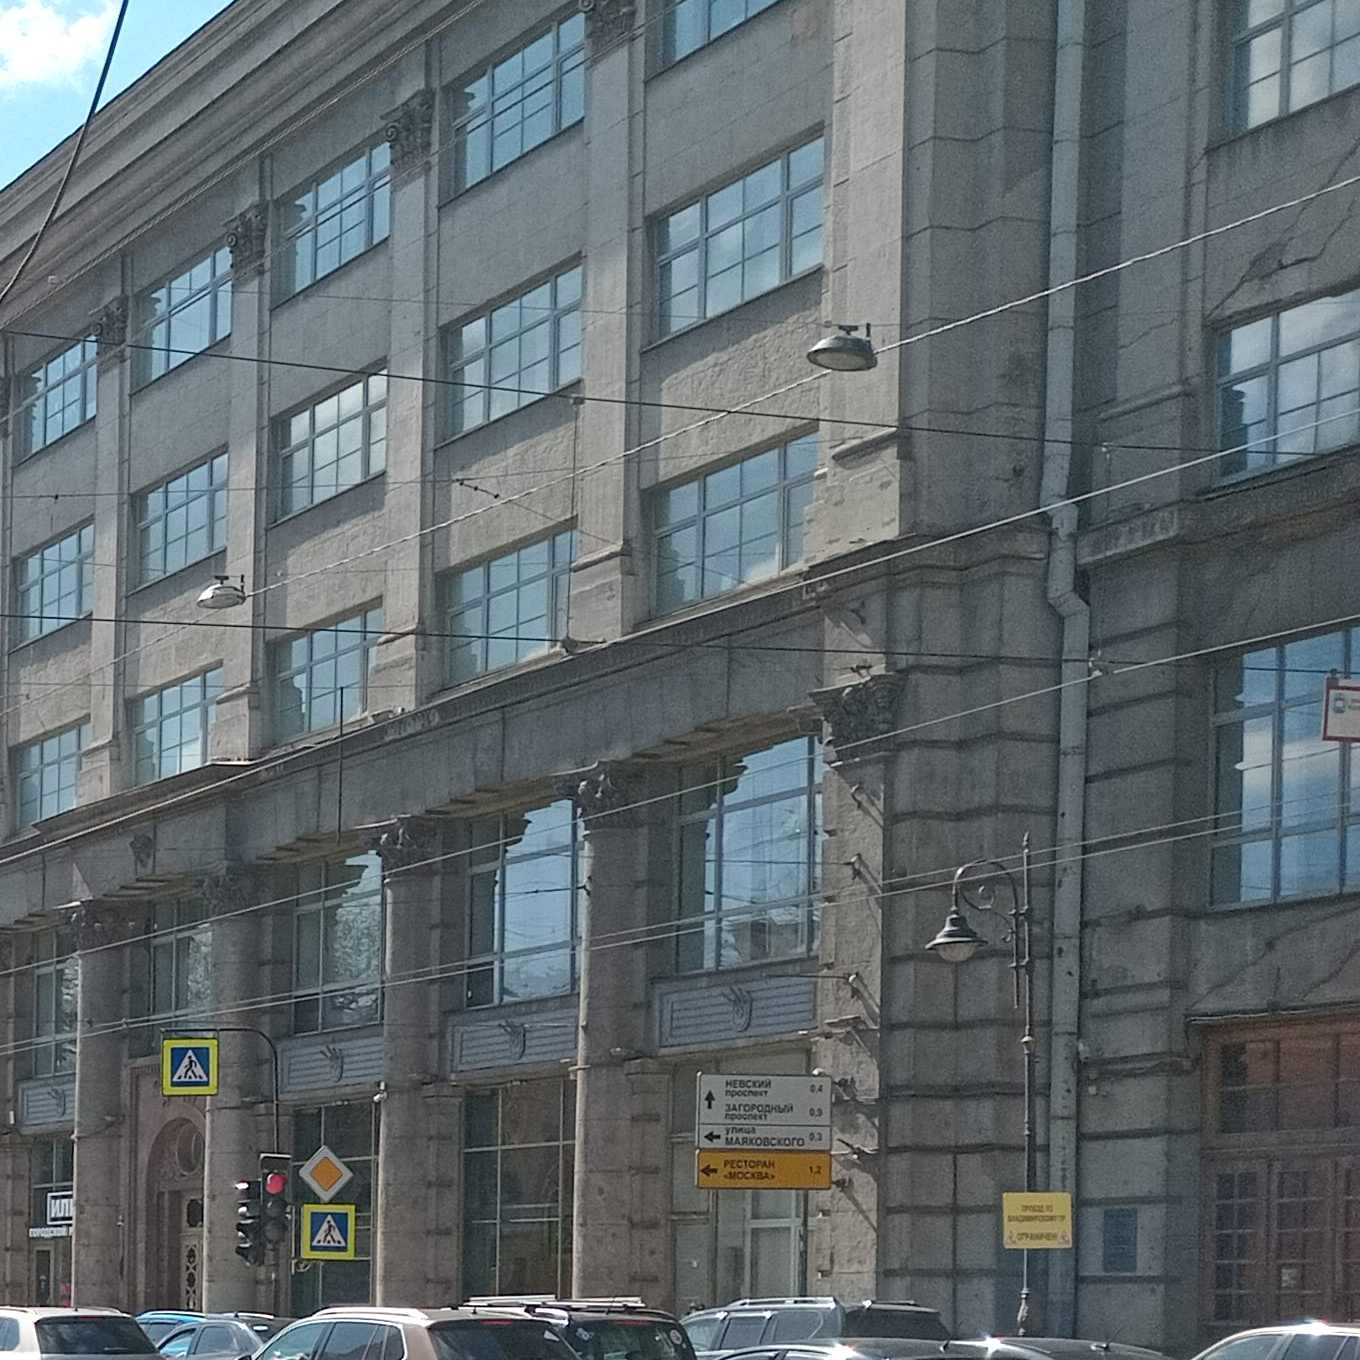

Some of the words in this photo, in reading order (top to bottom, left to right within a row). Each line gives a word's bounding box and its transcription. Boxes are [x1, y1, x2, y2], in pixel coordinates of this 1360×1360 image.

[724, 1078, 772, 1089] НЕВСКИЙ
[724, 1089, 768, 1097] проспект
[724, 1102, 794, 1113] ЗАГОРОДНЫЙ
[724, 1113, 768, 1121] проспект
[724, 1126, 756, 1135] улица
[724, 1136, 805, 1146] МАЯКОВСКОГО
[723, 1159, 775, 1169] РЕСТОРАН
[723, 1171, 776, 1180] «МОСКВА»
